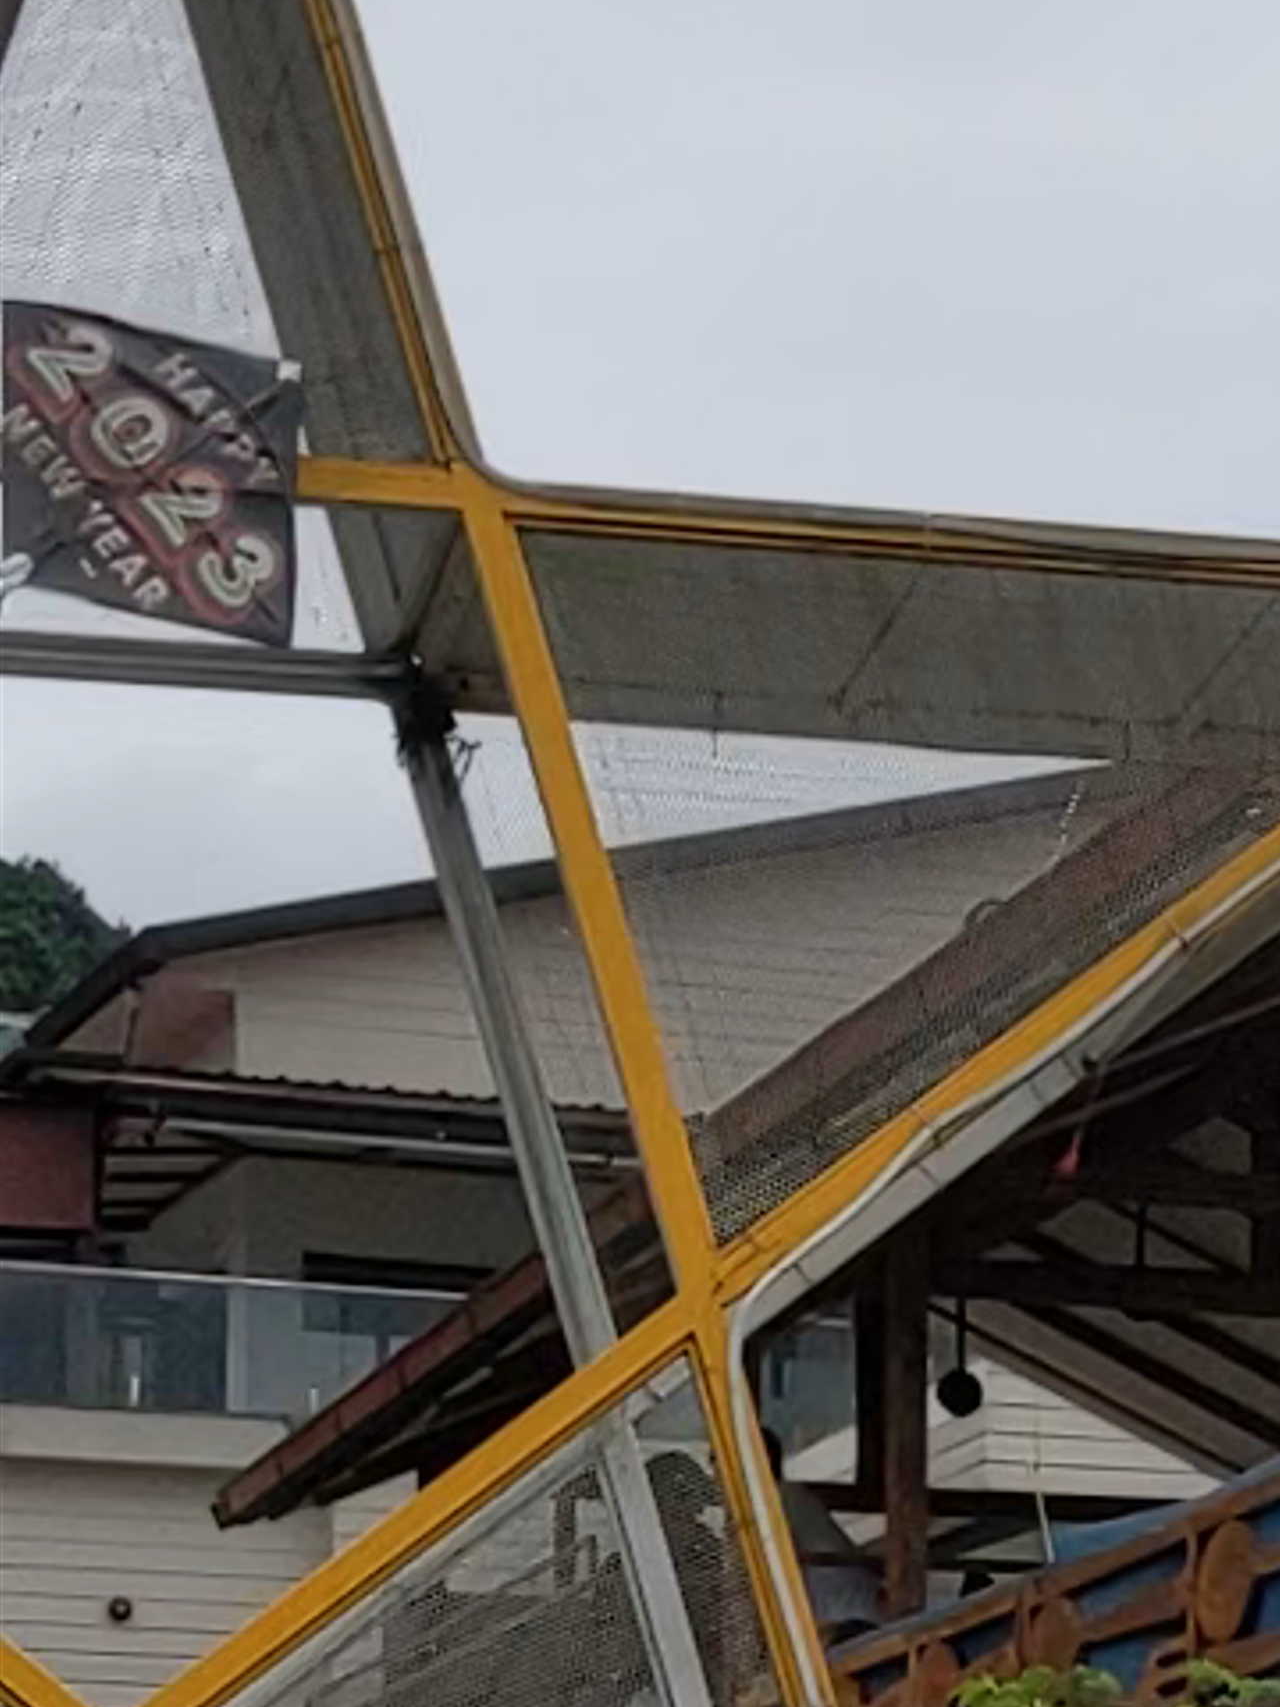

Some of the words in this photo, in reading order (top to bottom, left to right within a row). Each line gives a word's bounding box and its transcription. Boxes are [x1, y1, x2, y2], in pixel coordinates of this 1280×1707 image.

[1, 403, 86, 499] NEW
[77, 500, 170, 608] YEAR
[26, 326, 276, 607] 2023
